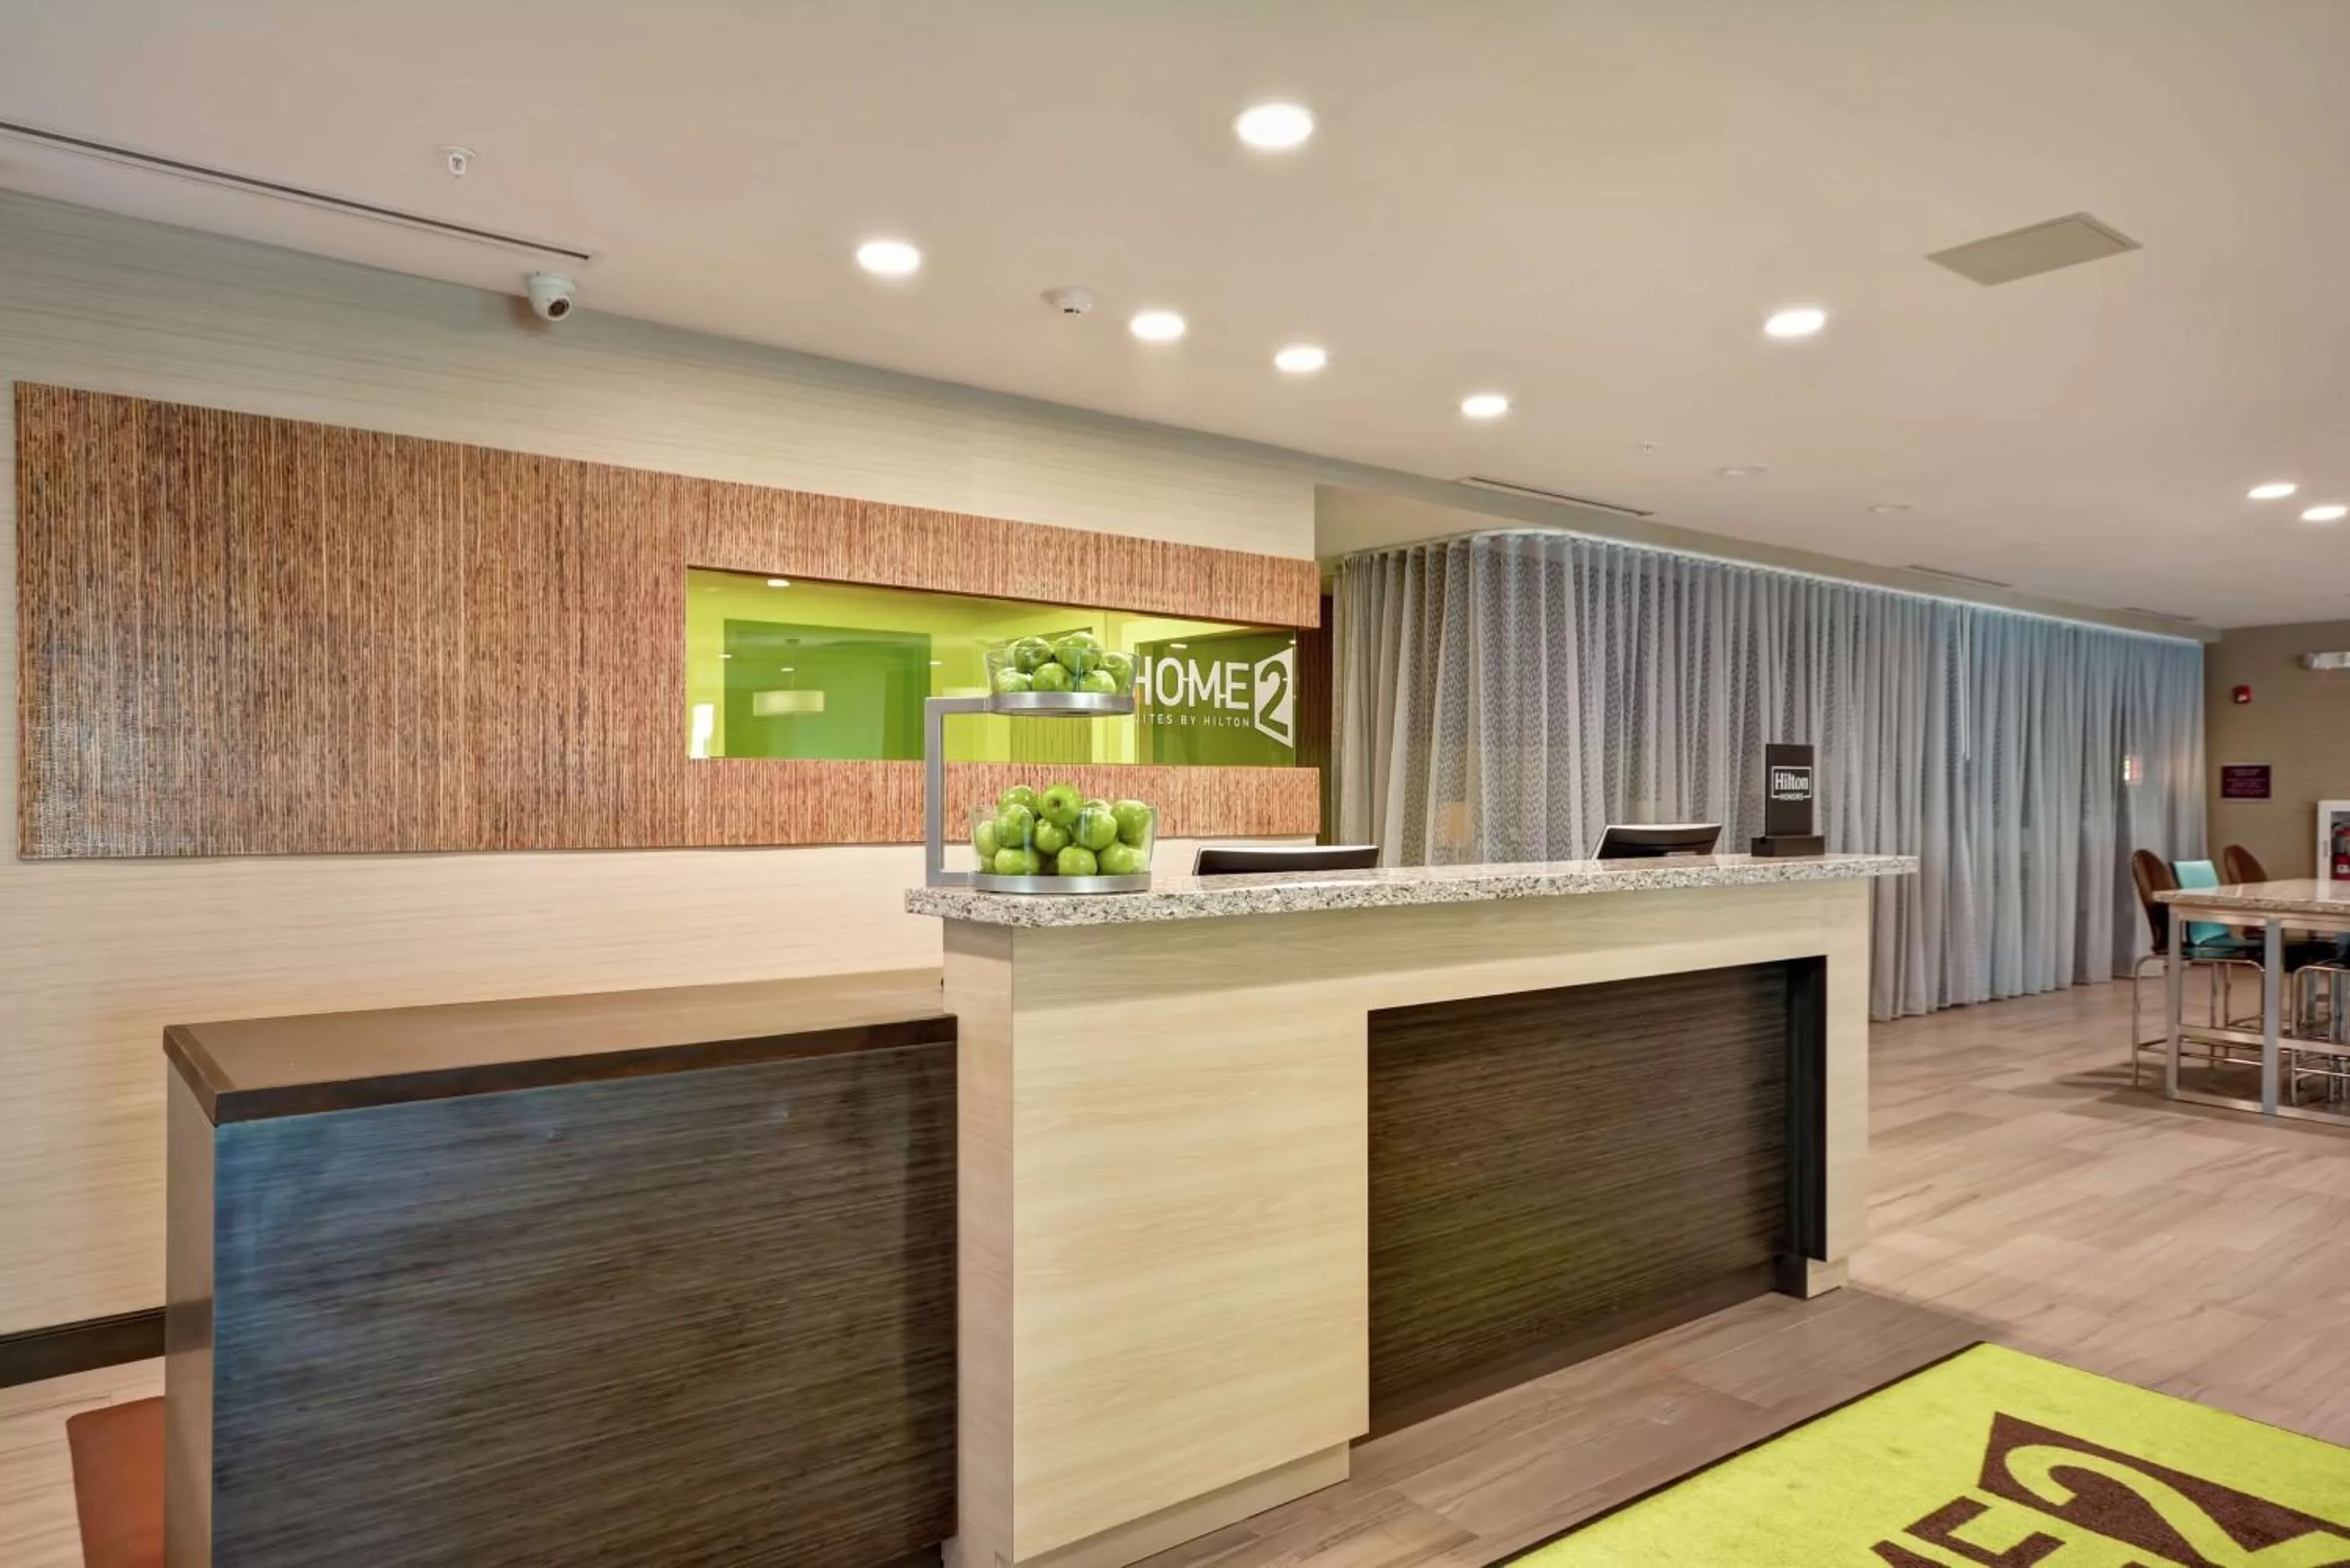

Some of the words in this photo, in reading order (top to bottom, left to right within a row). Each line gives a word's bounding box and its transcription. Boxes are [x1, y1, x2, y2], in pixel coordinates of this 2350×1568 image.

[1180, 714, 1196, 725] BY
[1203, 716, 1249, 728] HILTON
[1774, 771, 1809, 790] Hilton
